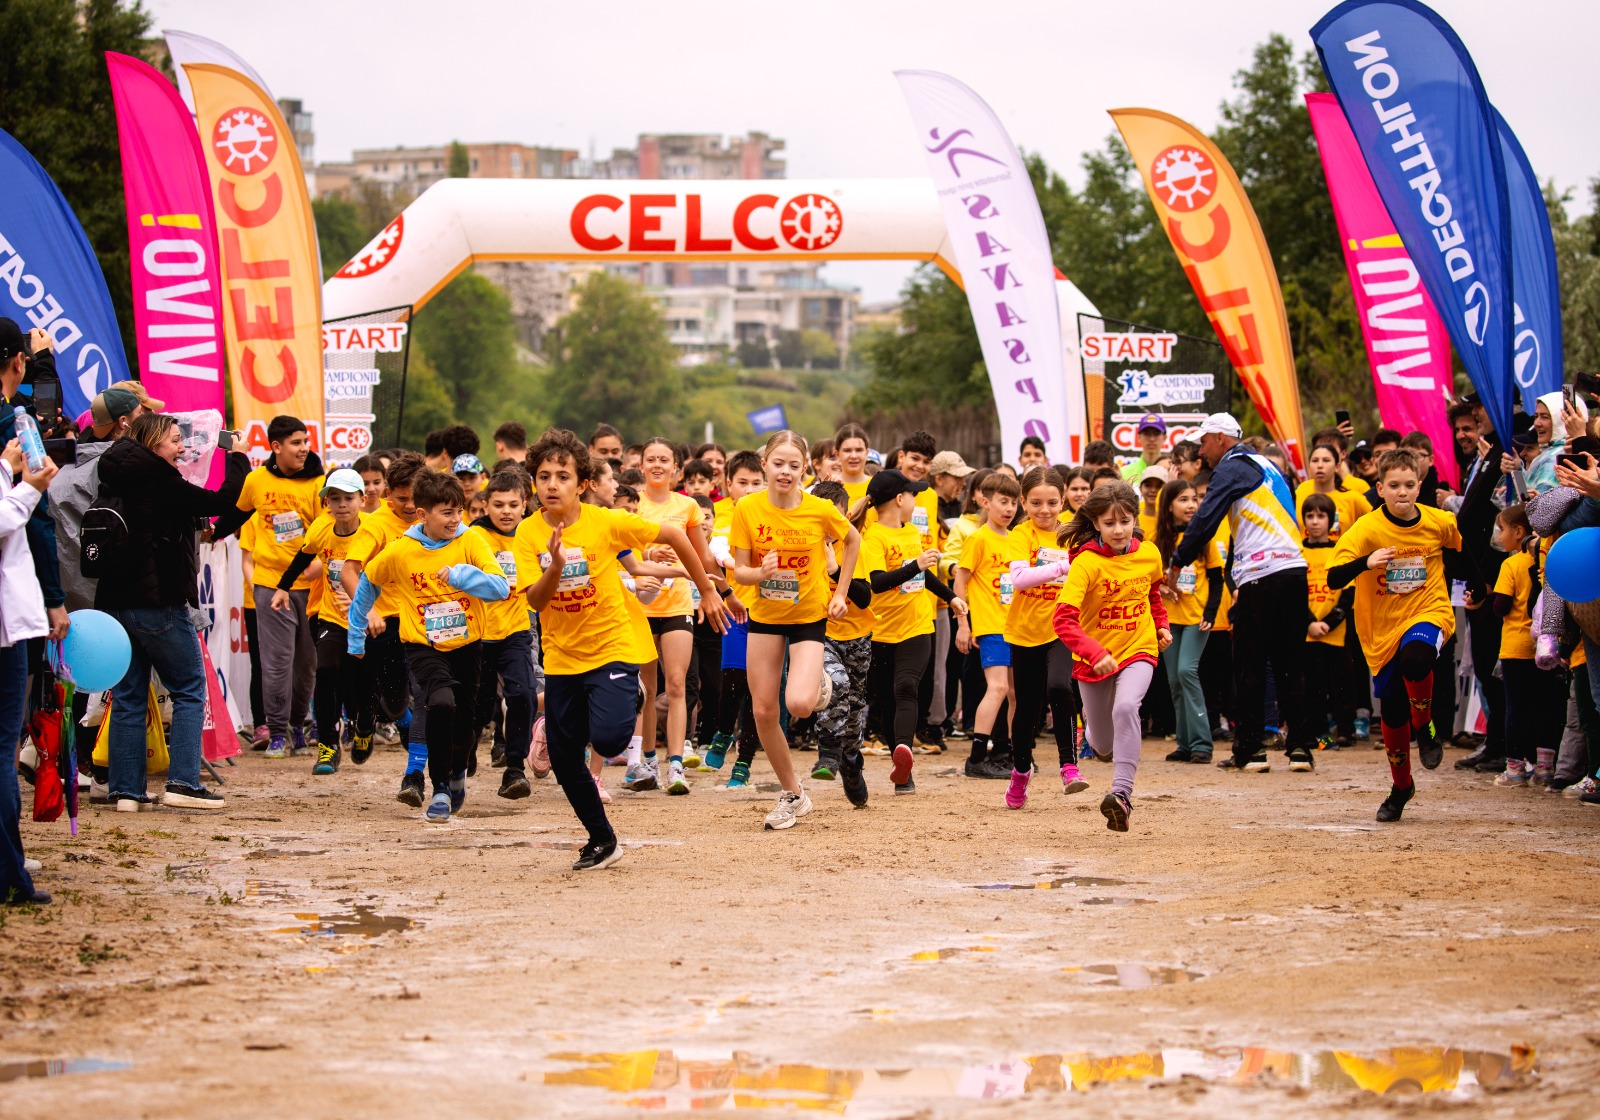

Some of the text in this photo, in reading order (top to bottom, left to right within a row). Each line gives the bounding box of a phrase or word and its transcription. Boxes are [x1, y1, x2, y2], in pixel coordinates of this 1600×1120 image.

[569, 193, 843, 252] CELCO
[1084, 336, 1173, 359] START
[323, 371, 378, 383] AMPIONII
[1153, 376, 1211, 388] CAMPIONII
[277, 521, 298, 532] 7108
[1391, 569, 1420, 580] 7340
[764, 580, 793, 590] 7130
[431, 614, 460, 628] 7187
